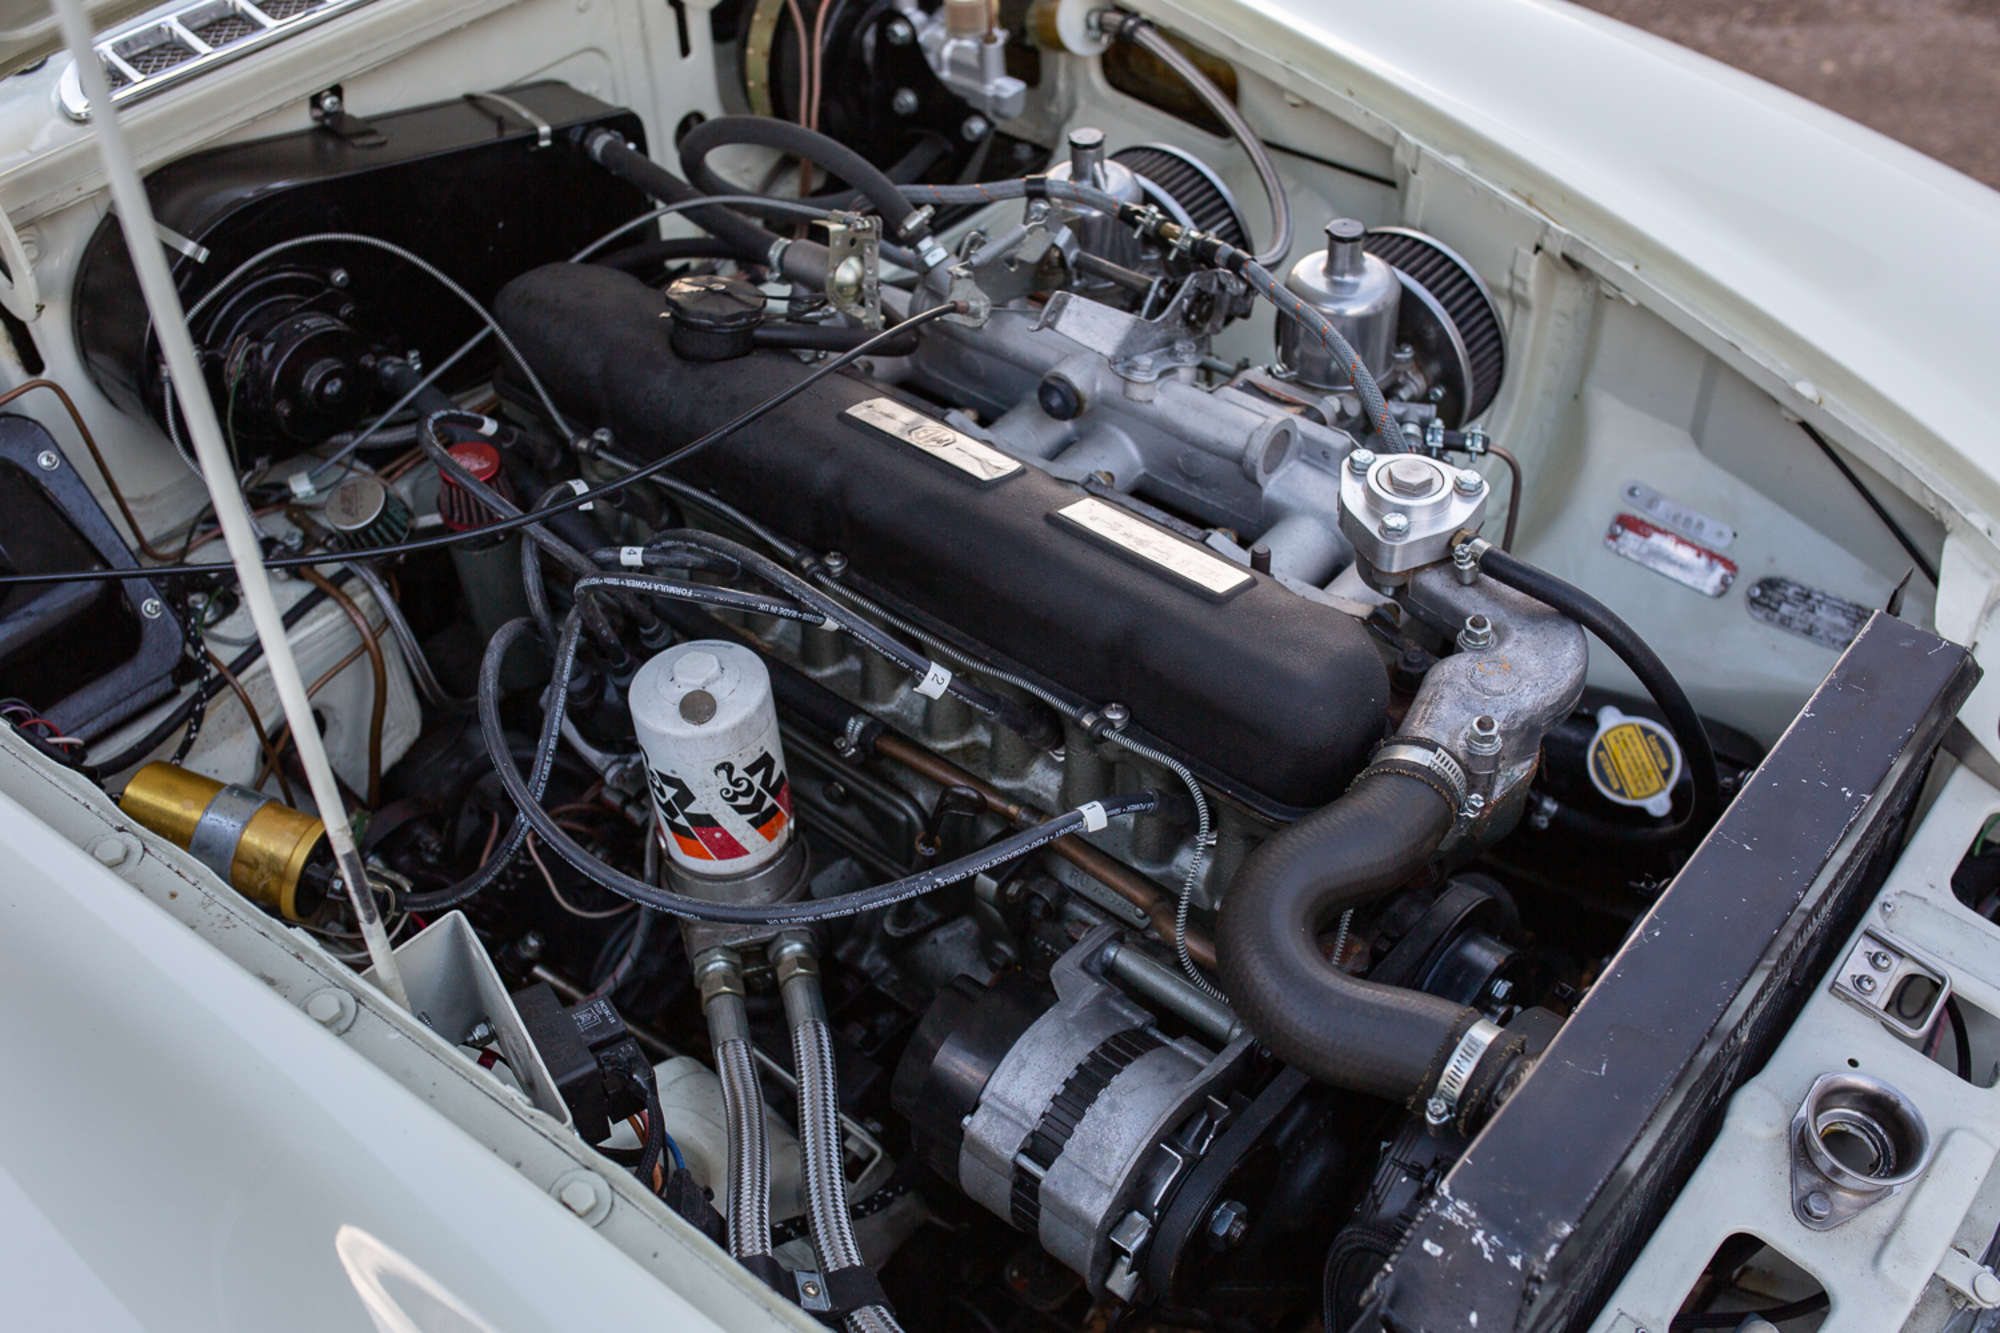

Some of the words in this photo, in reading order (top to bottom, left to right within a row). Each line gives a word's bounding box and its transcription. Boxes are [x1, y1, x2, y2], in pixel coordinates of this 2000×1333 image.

[626, 579, 652, 590] POWER
[652, 583, 692, 597] FORMULA
[931, 673, 945, 686] 2
[991, 836, 1049, 865] PERFORMANCE
[967, 861, 990, 876] RACE
[940, 870, 967, 887] CABLE
